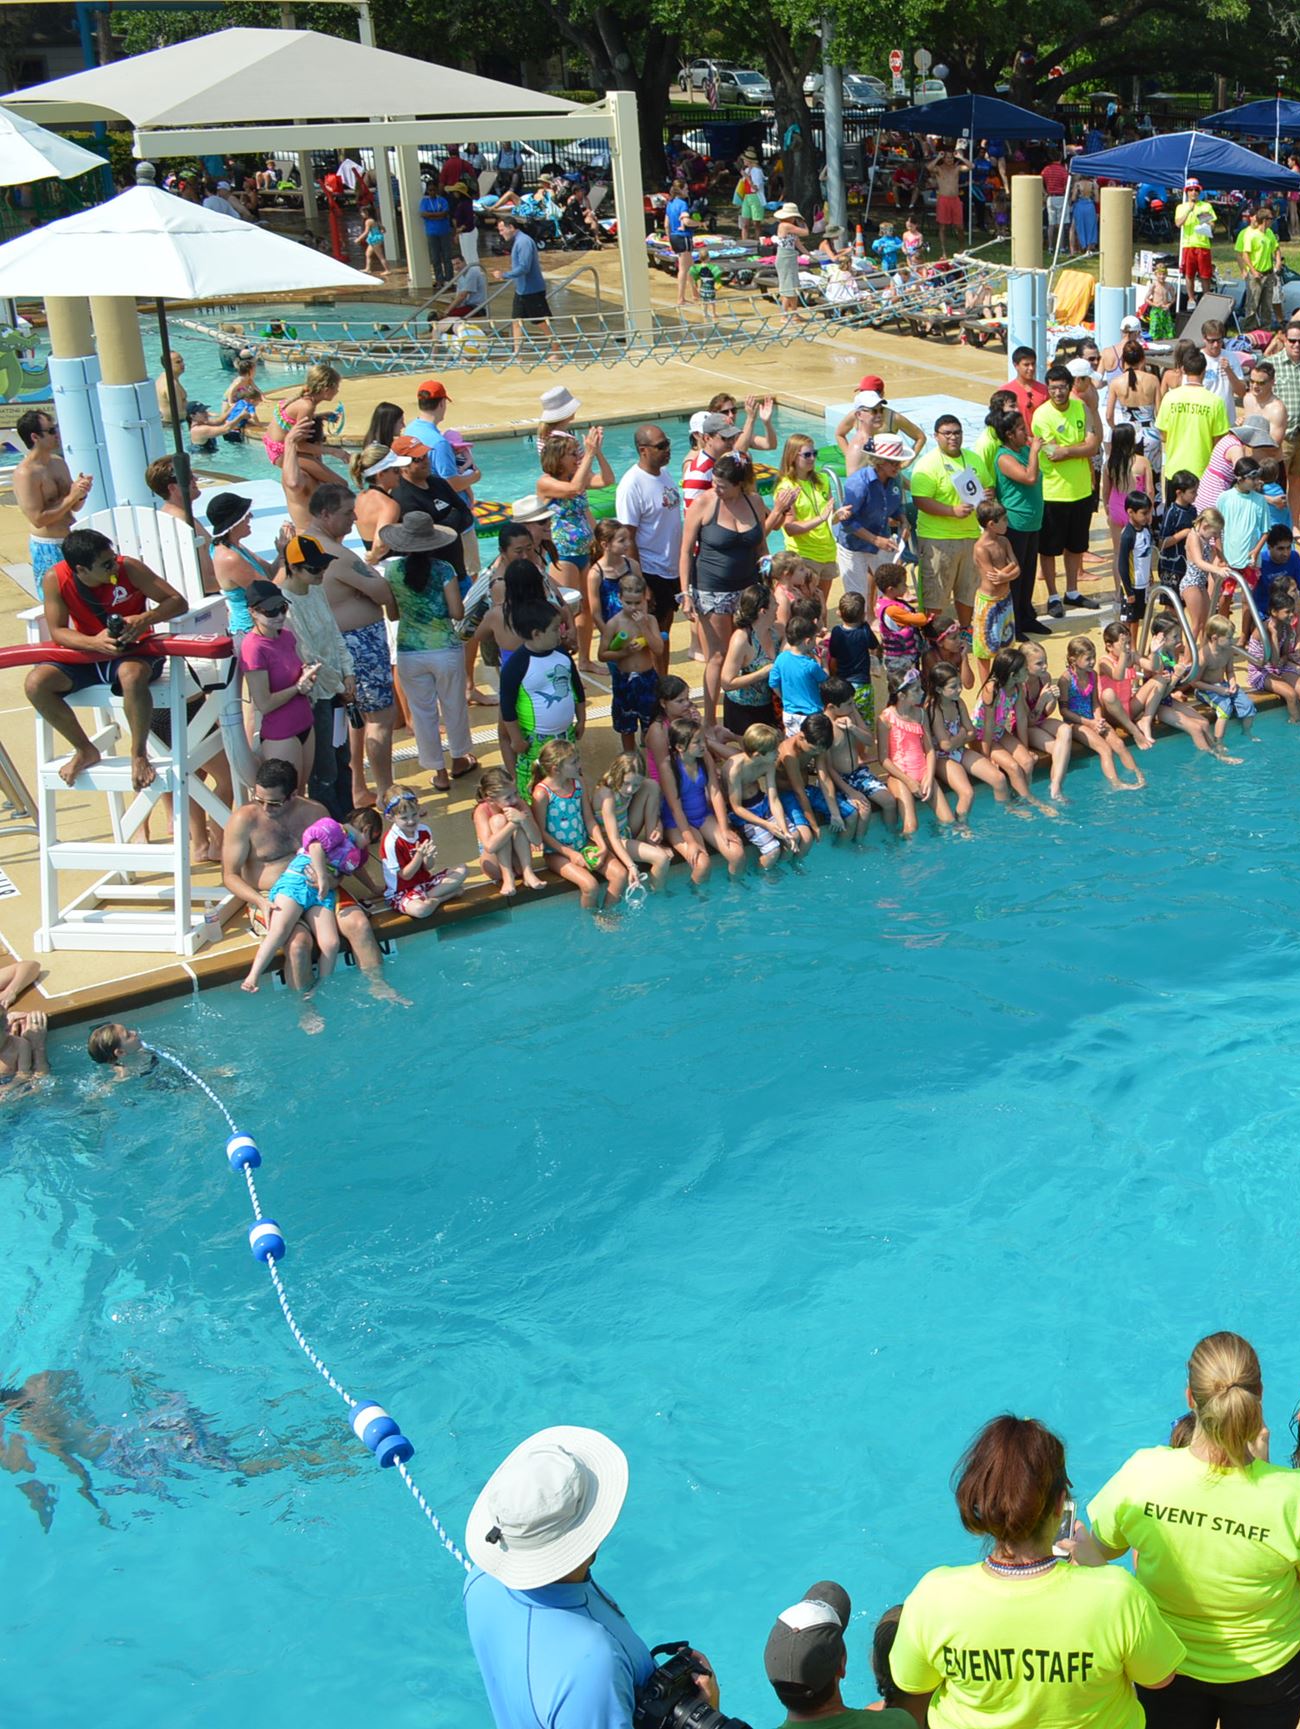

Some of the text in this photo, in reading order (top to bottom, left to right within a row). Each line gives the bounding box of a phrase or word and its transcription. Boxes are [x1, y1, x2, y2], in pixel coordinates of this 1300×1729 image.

[1171, 402, 1211, 416] EVENT STAFF
[966, 480, 977, 496] 9
[1144, 1501, 1271, 1542] EVENT STAFF
[943, 1644, 1094, 1683] EVENT STAFF
